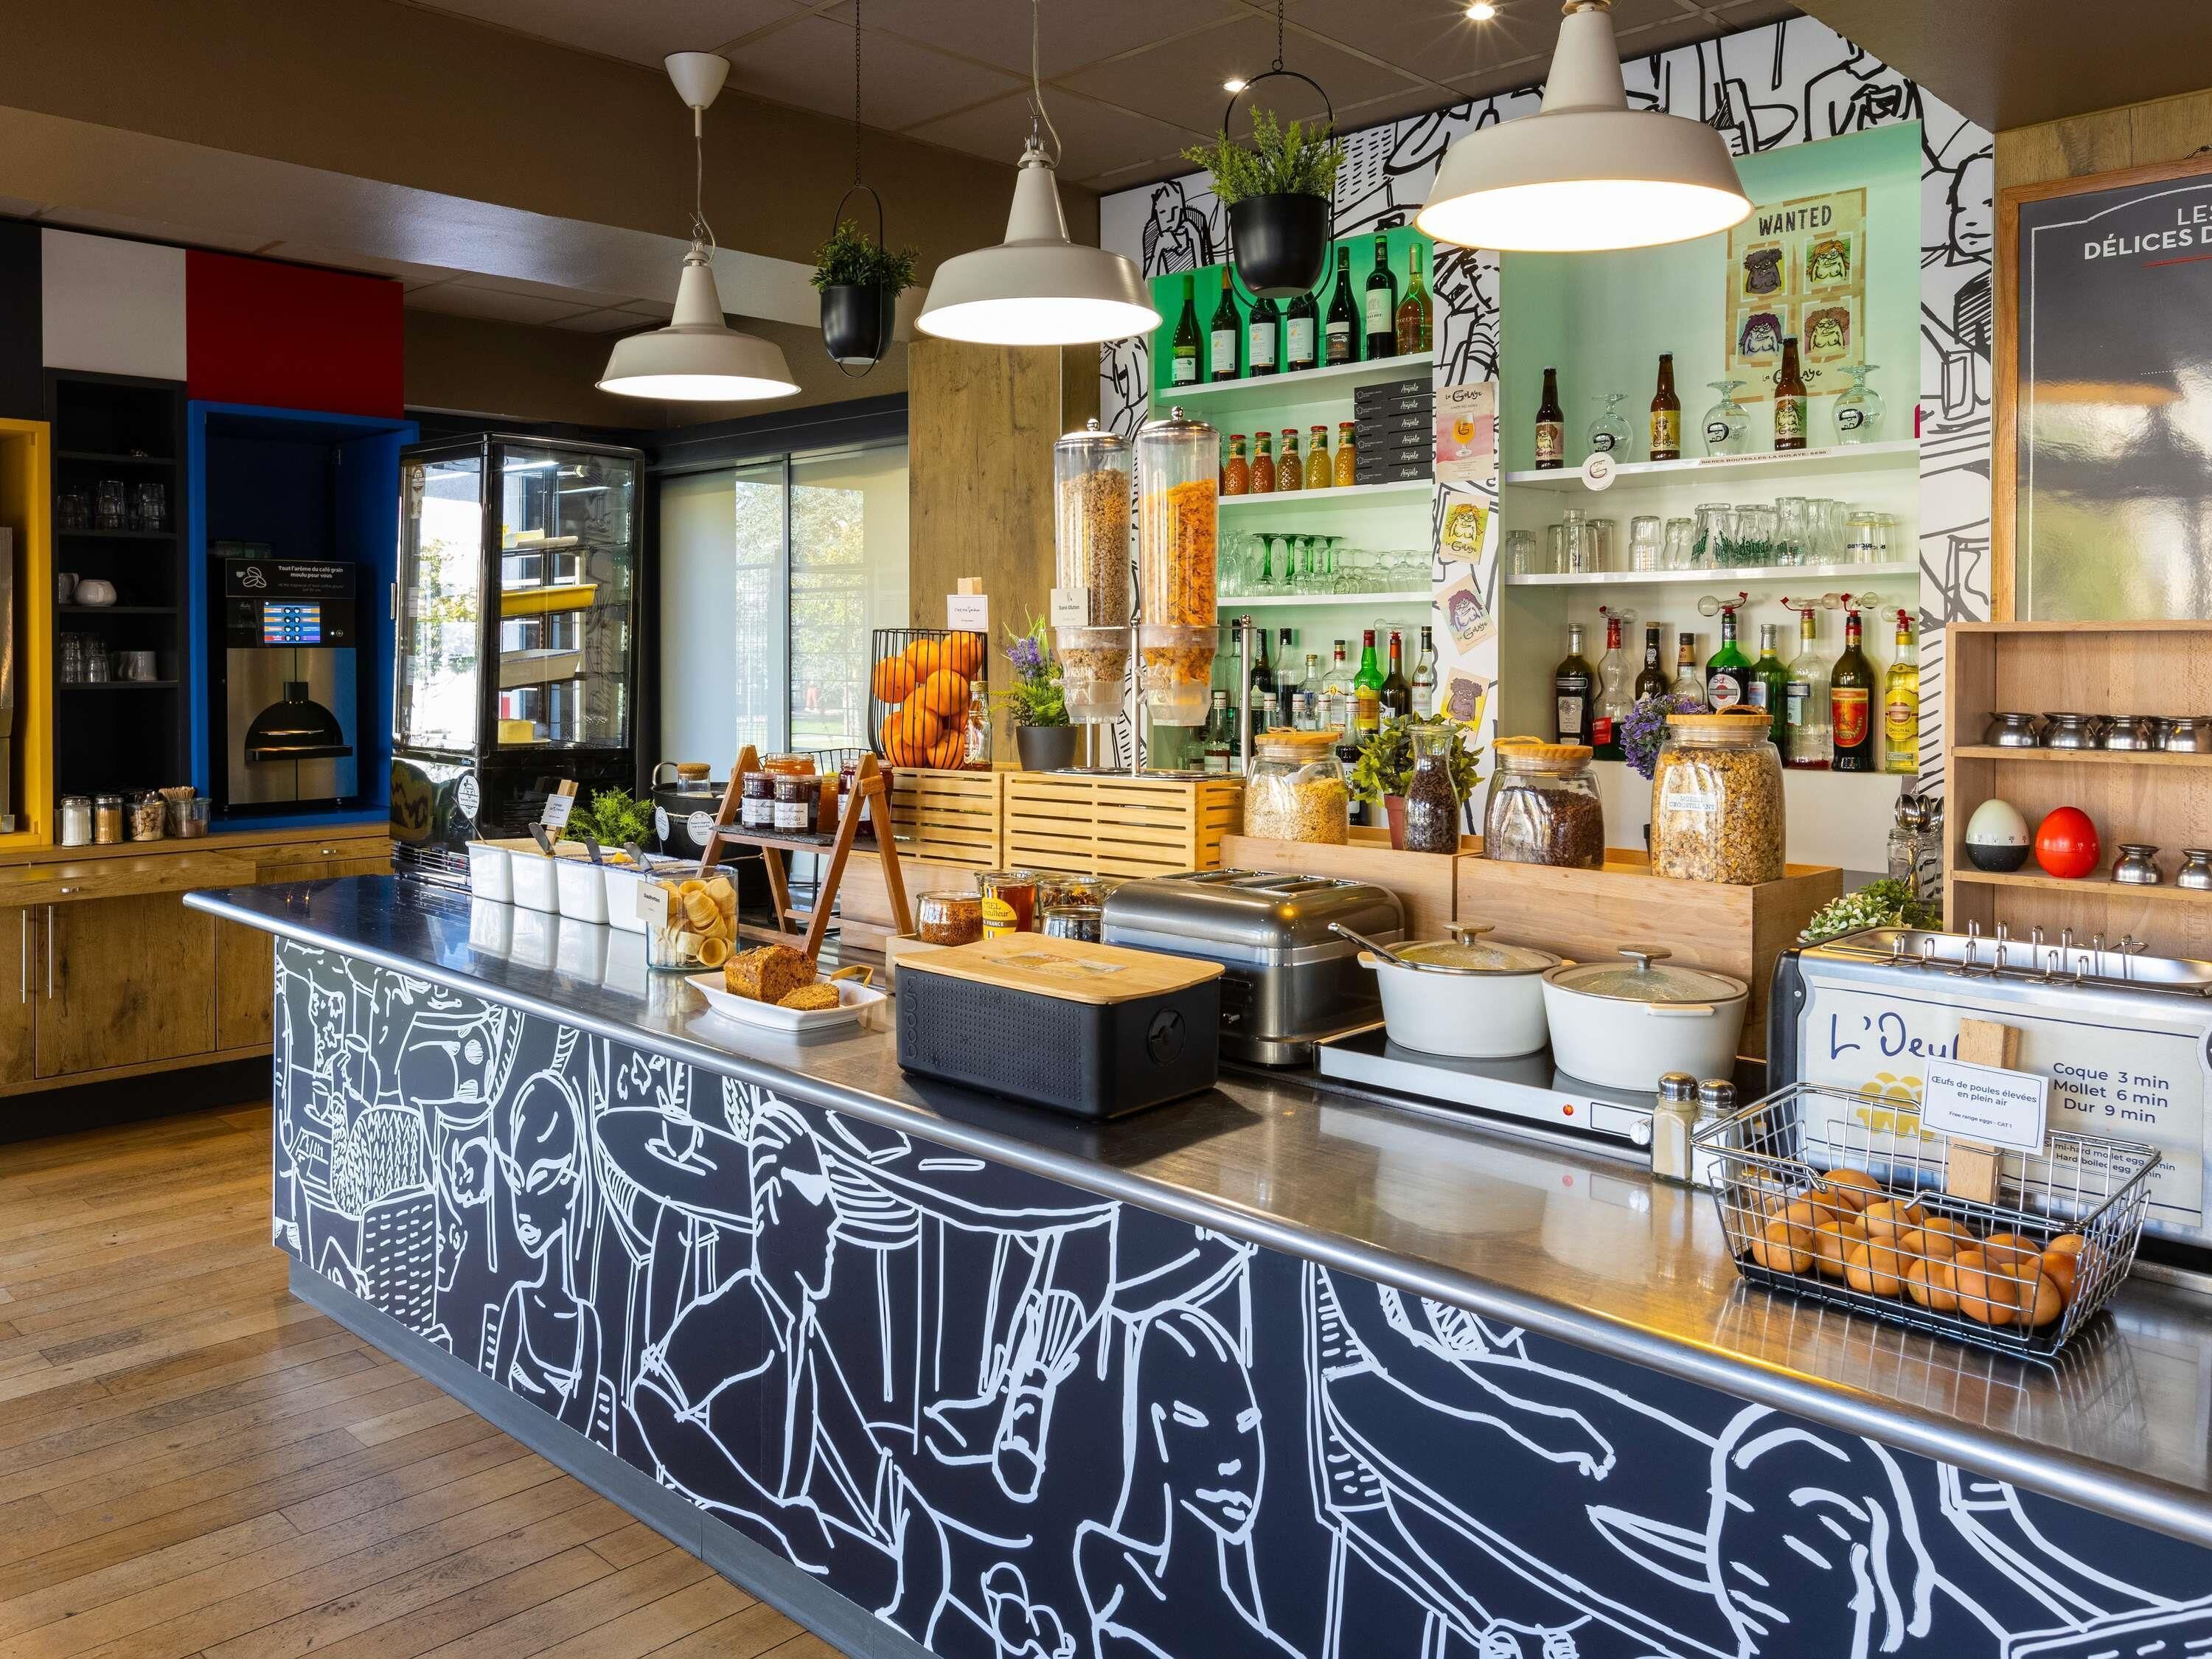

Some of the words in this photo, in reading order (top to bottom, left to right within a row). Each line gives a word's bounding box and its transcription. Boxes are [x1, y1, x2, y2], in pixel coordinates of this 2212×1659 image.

[1759, 205, 1832, 236] WANTED
[2084, 229, 2193, 260] DÉLICES
[1931, 1076, 1954, 1086] Œufs
[1969, 1084, 2000, 1096] poules
[2002, 1090, 2037, 1103] élevées
[2053, 1062, 2109, 1080] Coque
[2118, 1071, 2128, 1083] 3
[2134, 1076, 2169, 1090] min
[1971, 1093, 1993, 1104] plein
[2053, 1079, 2107, 1098] Mollet
[2117, 1090, 2127, 1101] 6
[2133, 1093, 2168, 1107] min
[2064, 1098, 2096, 1113] Dur
[2105, 1105, 2115, 1116] 9
[2121, 1109, 2155, 1124] min
[2056, 1152, 2078, 1164] Hard
[2112, 1164, 2131, 1174] egg
[2093, 1149, 2124, 1161] molet
[2126, 1157, 2144, 1166] egg
